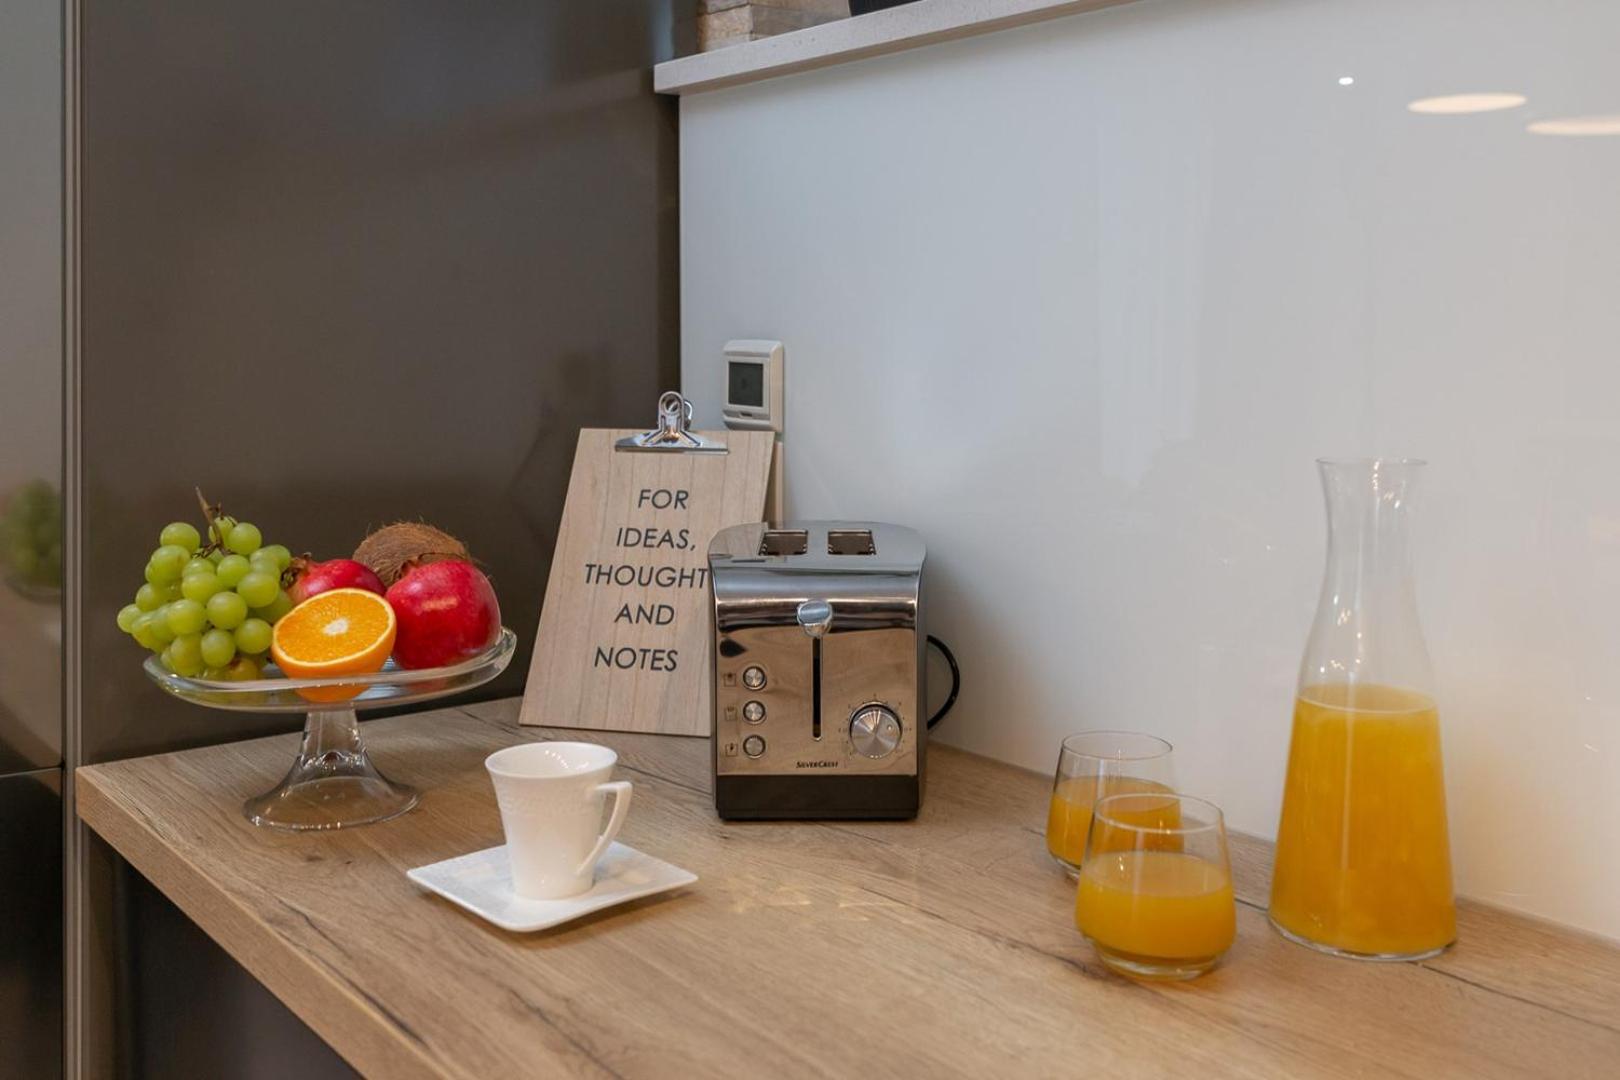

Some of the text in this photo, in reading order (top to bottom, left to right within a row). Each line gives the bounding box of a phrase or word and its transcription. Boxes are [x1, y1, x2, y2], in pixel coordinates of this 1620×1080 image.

[638, 489, 689, 509] FOR
[616, 528, 696, 551] IDEAS,
[614, 603, 675, 625] AND
[594, 646, 678, 672] NOTES
